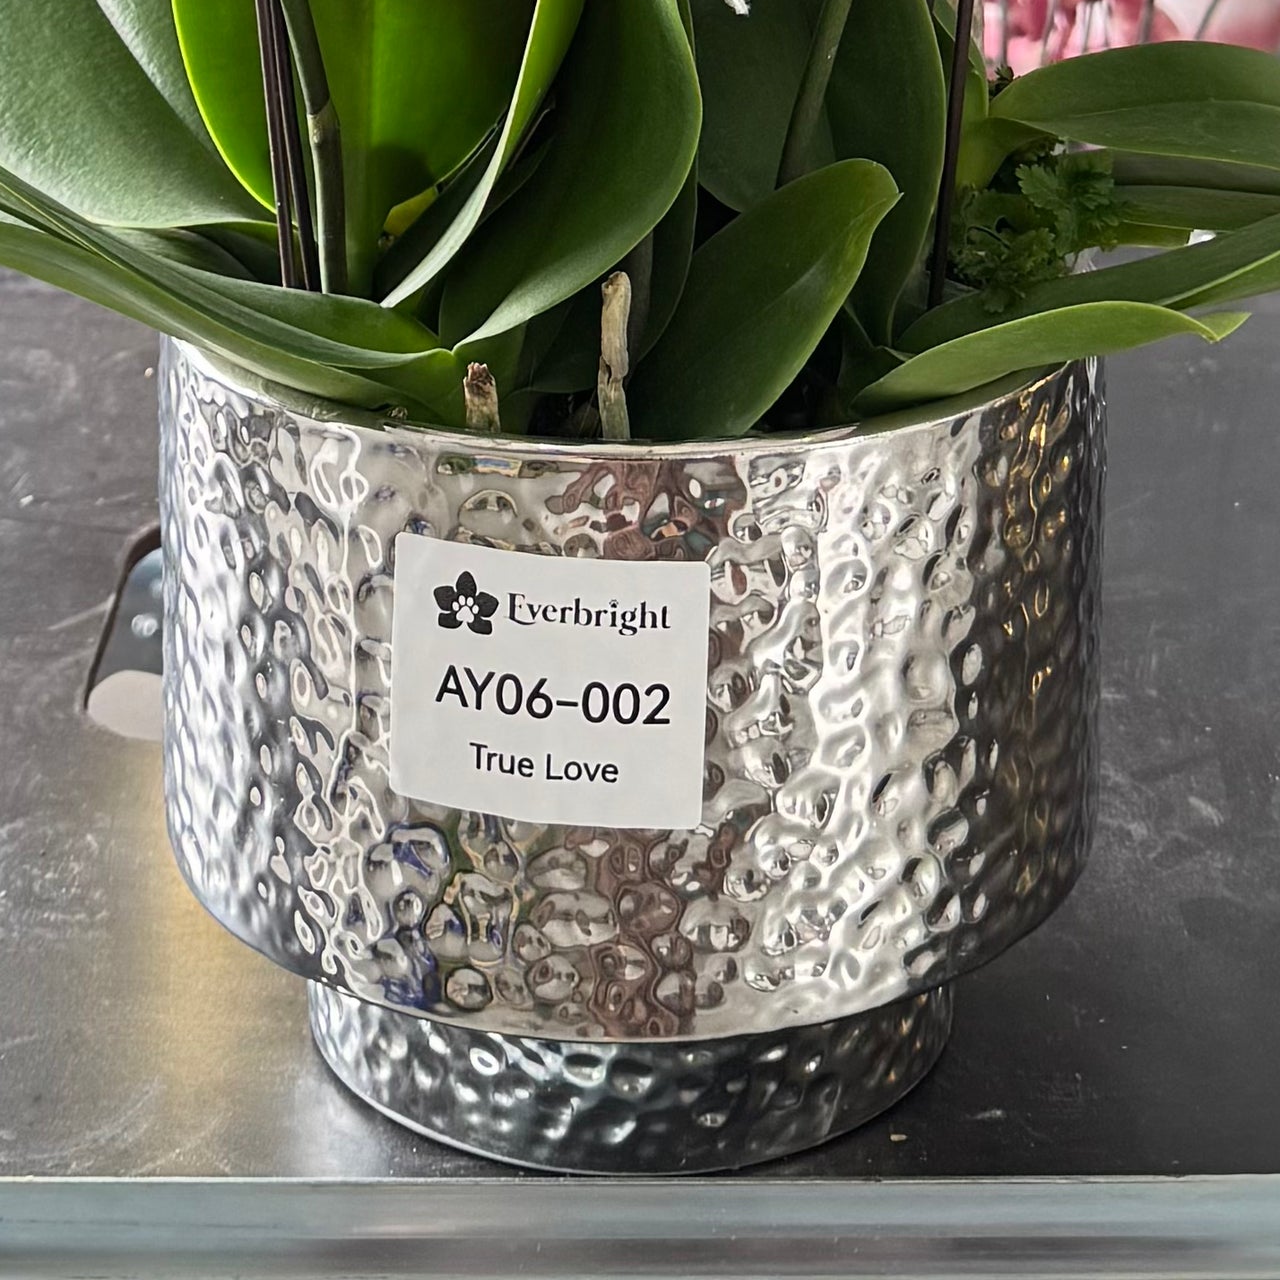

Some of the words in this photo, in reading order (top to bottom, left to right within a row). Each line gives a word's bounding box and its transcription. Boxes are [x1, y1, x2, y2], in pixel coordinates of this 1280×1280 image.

[507, 592, 671, 636] Everbright
[435, 664, 671, 725] AY06-002
[469, 741, 535, 778] True
[545, 753, 619, 784] Love
